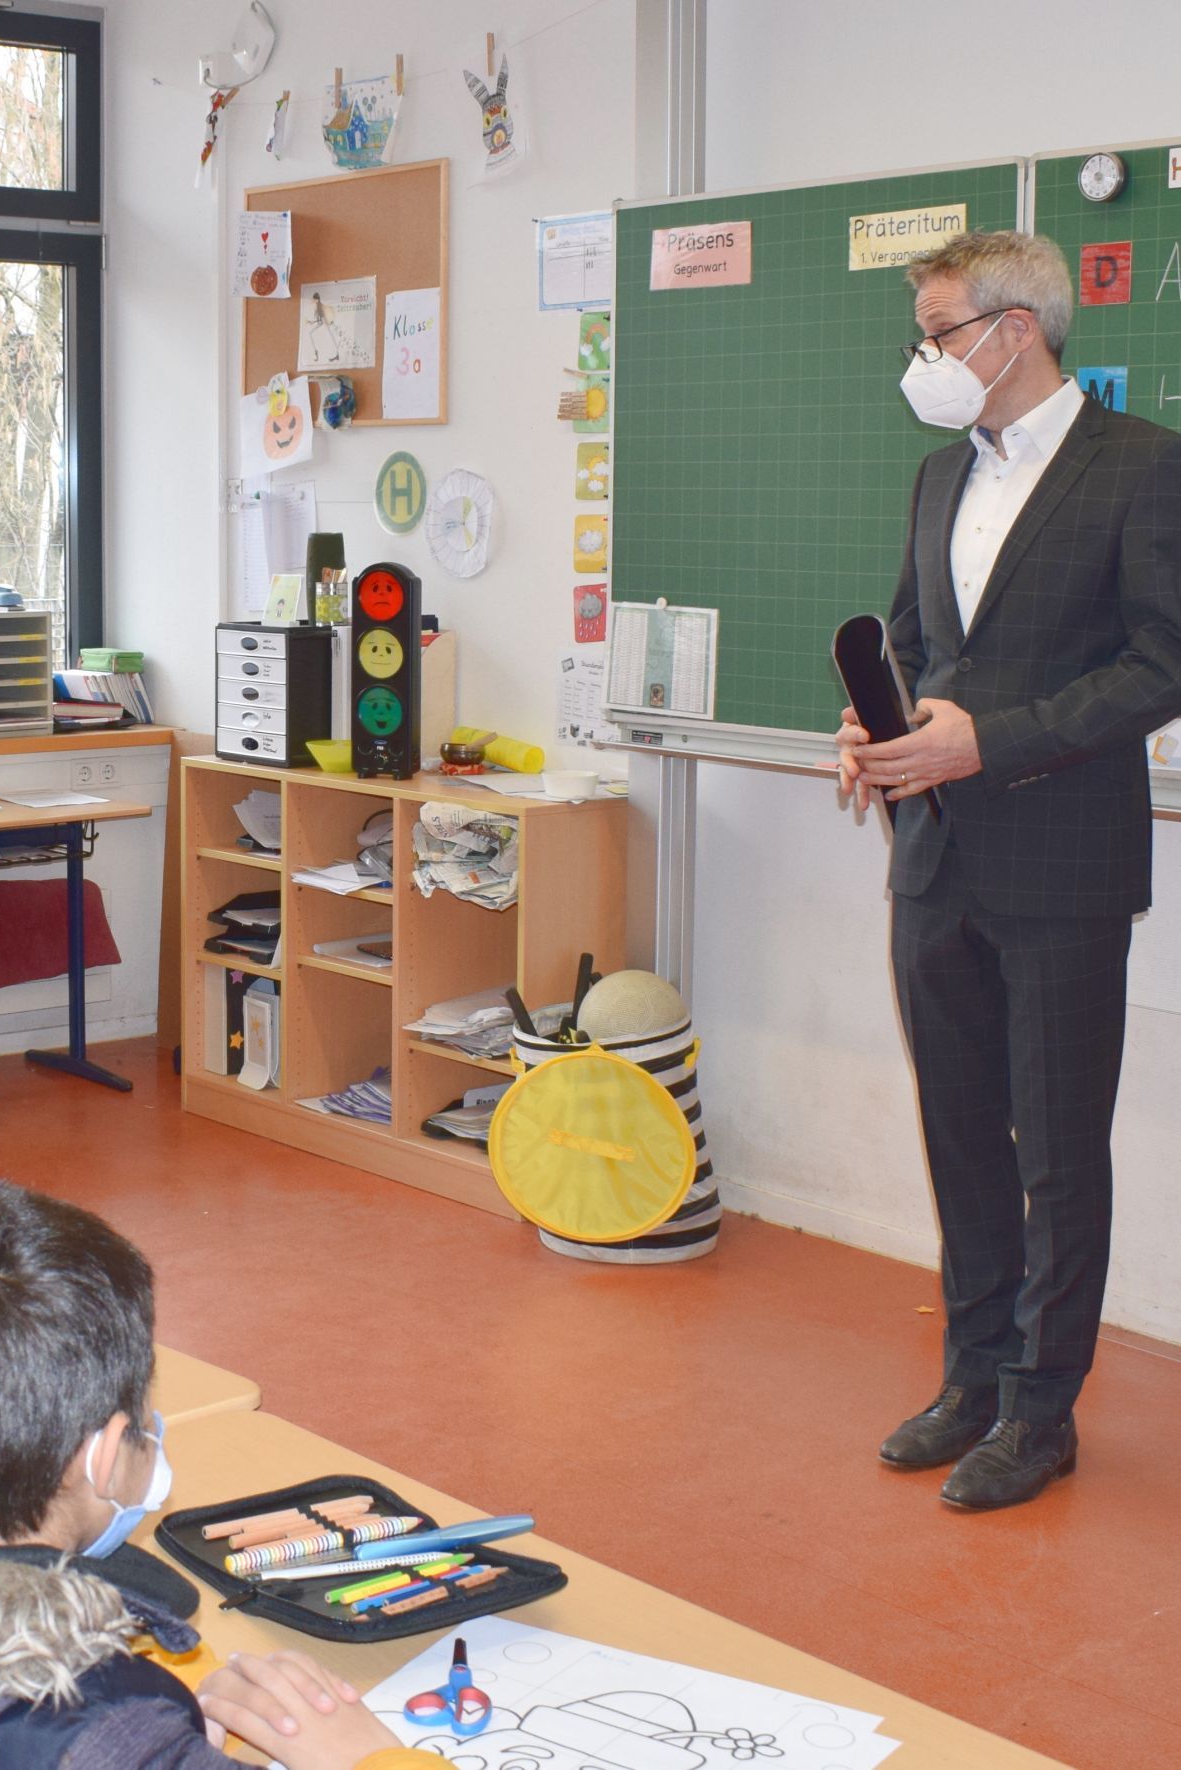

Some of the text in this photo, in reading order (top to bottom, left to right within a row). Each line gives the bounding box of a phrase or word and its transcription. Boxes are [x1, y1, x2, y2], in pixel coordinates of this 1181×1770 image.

[854, 212, 961, 240] Präteritum
[667, 232, 735, 253] Präsens
[674, 260, 728, 278] Gegenwart
[1094, 256, 1119, 289] D
[392, 313, 434, 341] Klasse
